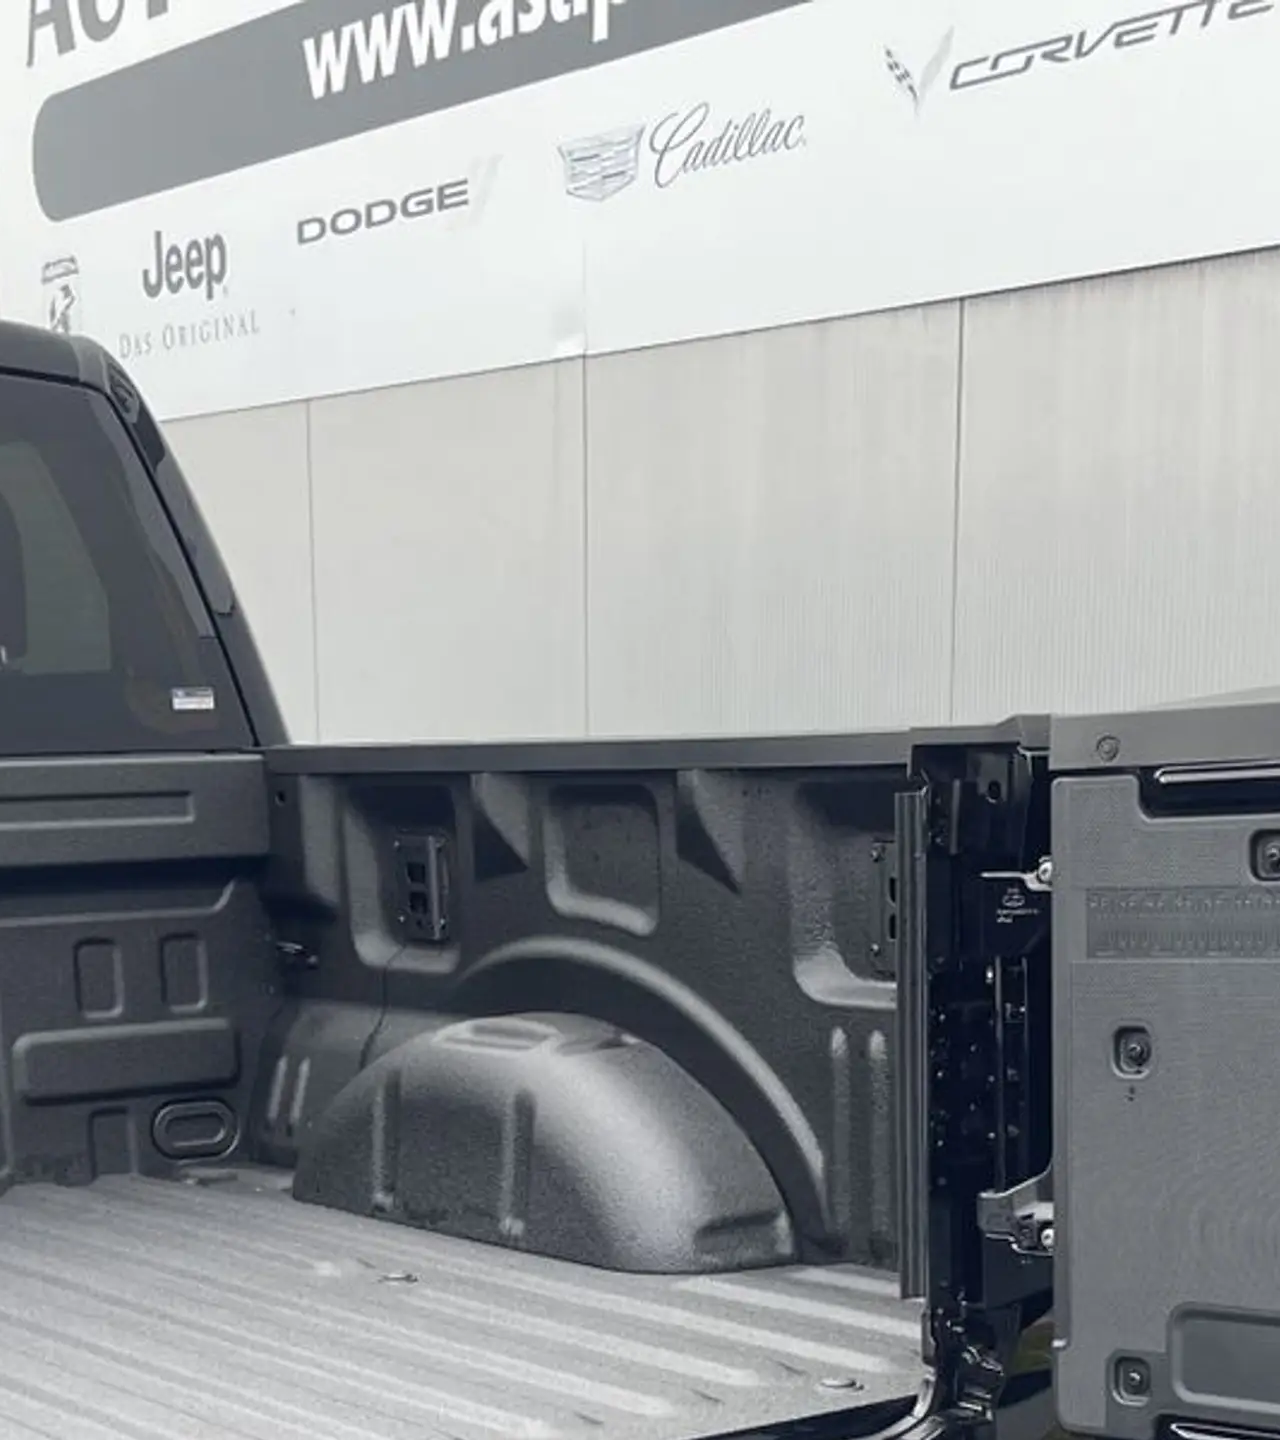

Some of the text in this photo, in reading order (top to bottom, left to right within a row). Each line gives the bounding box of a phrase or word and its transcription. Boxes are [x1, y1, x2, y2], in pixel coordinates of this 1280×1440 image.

[649, 101, 805, 189] Cadillac
[296, 177, 470, 245] DODGE
[142, 230, 227, 300] Jeep
